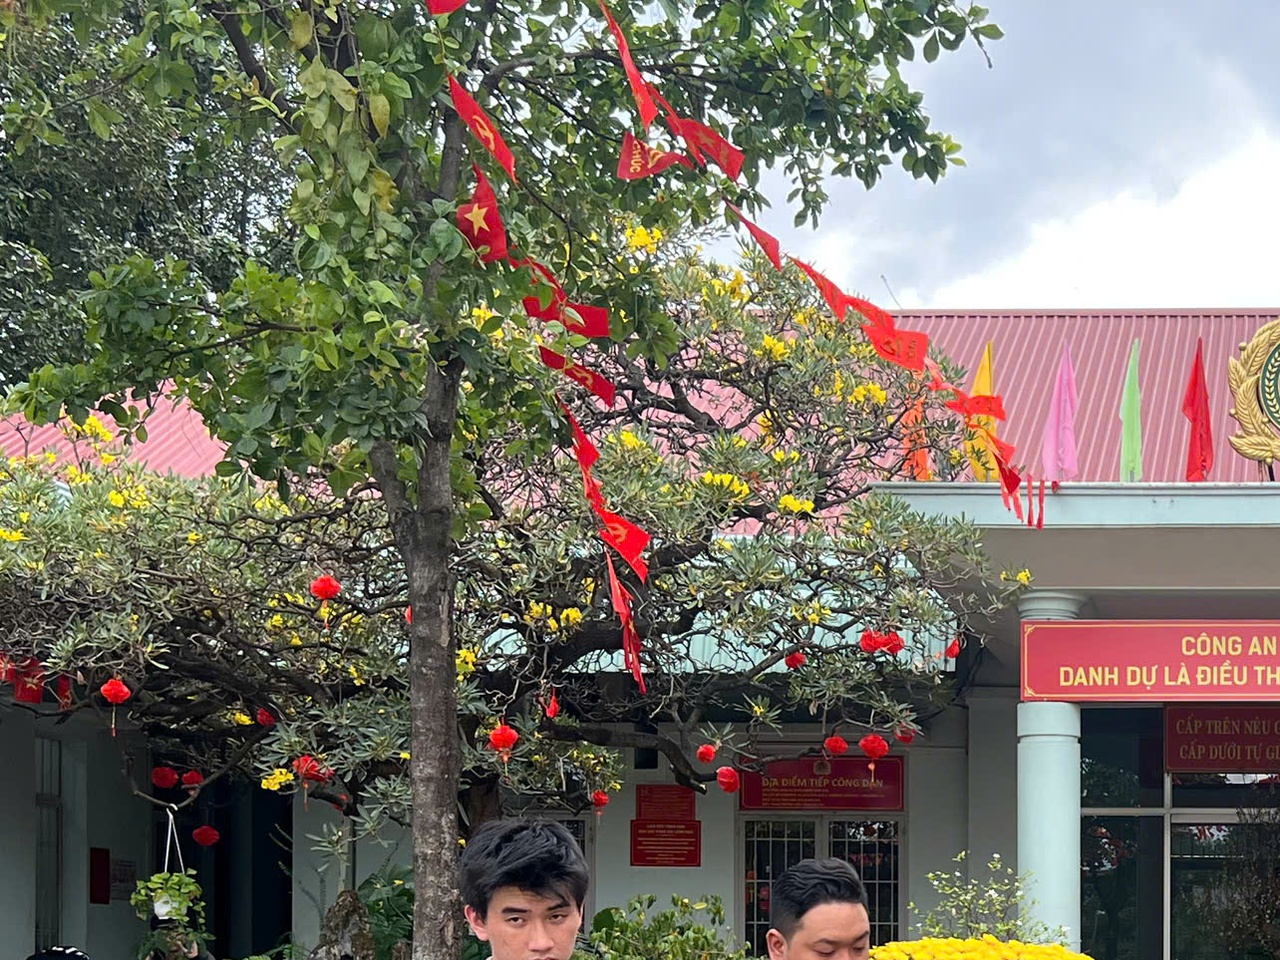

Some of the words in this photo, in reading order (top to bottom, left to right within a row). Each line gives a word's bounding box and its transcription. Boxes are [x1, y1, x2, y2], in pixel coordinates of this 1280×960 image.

[1181, 632, 1242, 656] CÔNG
[1248, 636, 1277, 656] AN
[1059, 666, 1119, 686] DANH
[1126, 664, 1158, 690] DỰ
[1164, 662, 1191, 686] LÀ
[1196, 659, 1248, 686] ĐIỀU
[1175, 713, 1202, 735] CẤP
[1205, 716, 1240, 735] TRÊN
[1244, 716, 1270, 735] NÊU
[1179, 738, 1205, 760] CẤP
[1209, 741, 1241, 760] DƯỚI
[1245, 742, 1262, 763] TỰ
[831, 776, 860, 788] CÔNG
